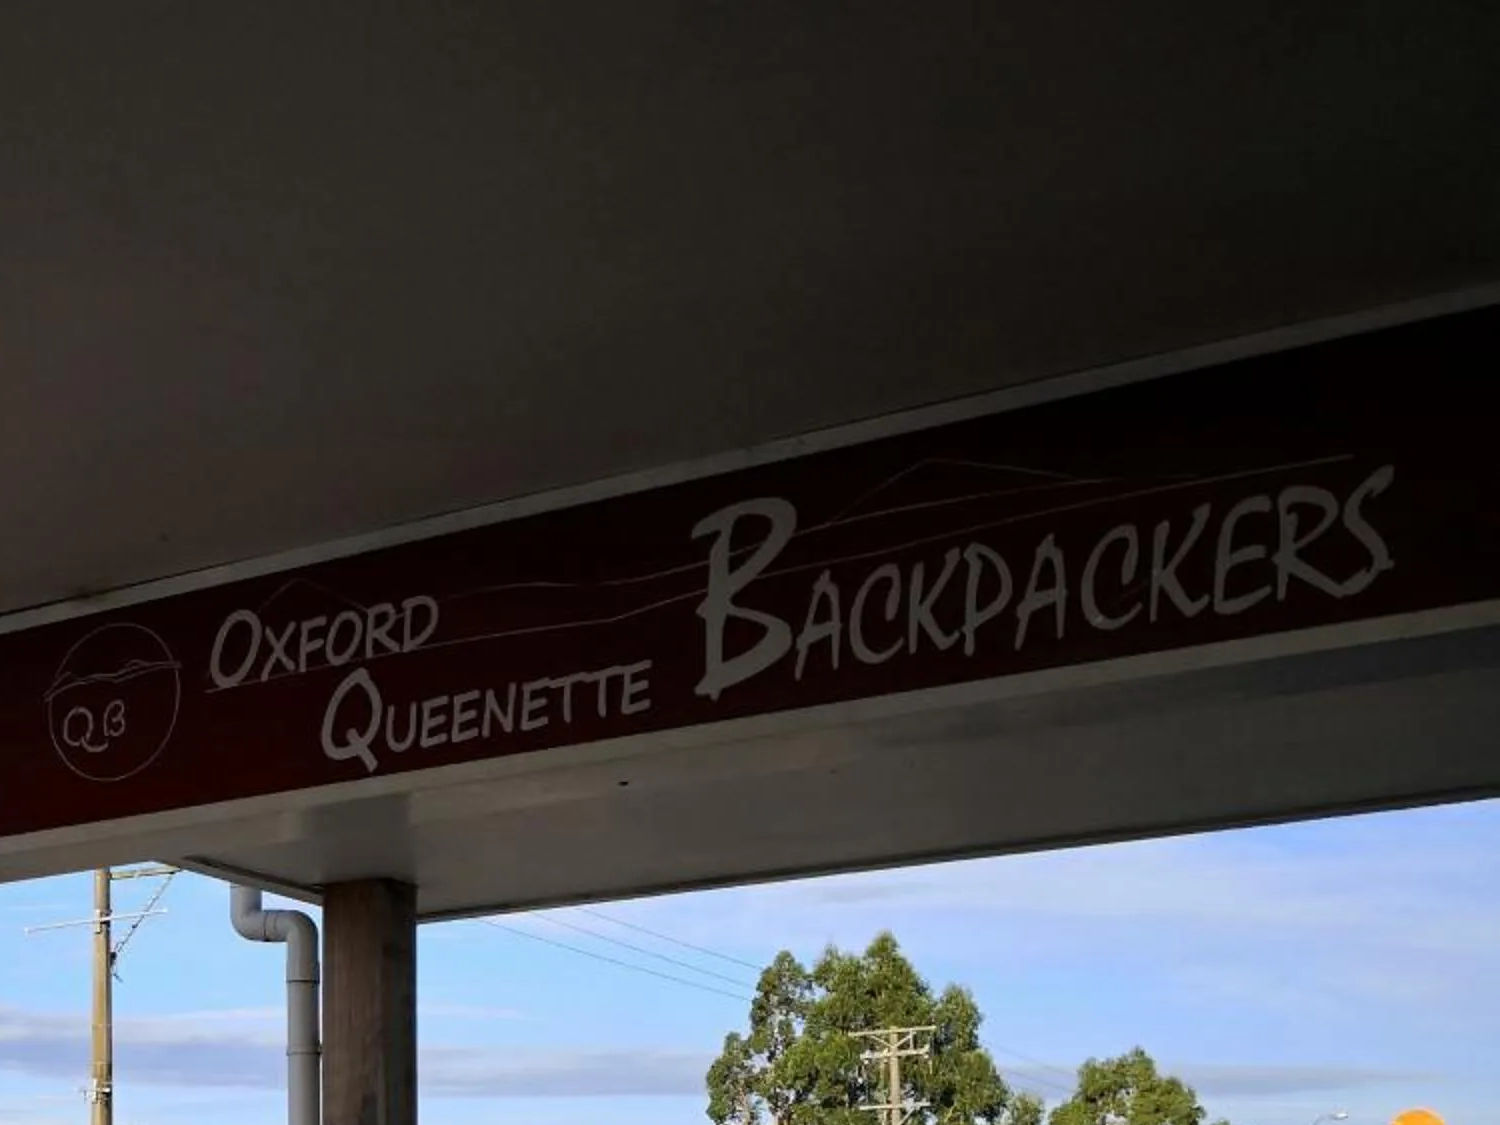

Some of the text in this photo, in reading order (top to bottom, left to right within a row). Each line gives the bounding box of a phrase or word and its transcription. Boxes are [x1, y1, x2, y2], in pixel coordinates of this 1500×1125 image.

[691, 465, 1395, 700] BACKPACKERS
[209, 595, 440, 689] OXFORD
[62, 700, 126, 753] QB
[320, 659, 653, 772] QUEENETTE
